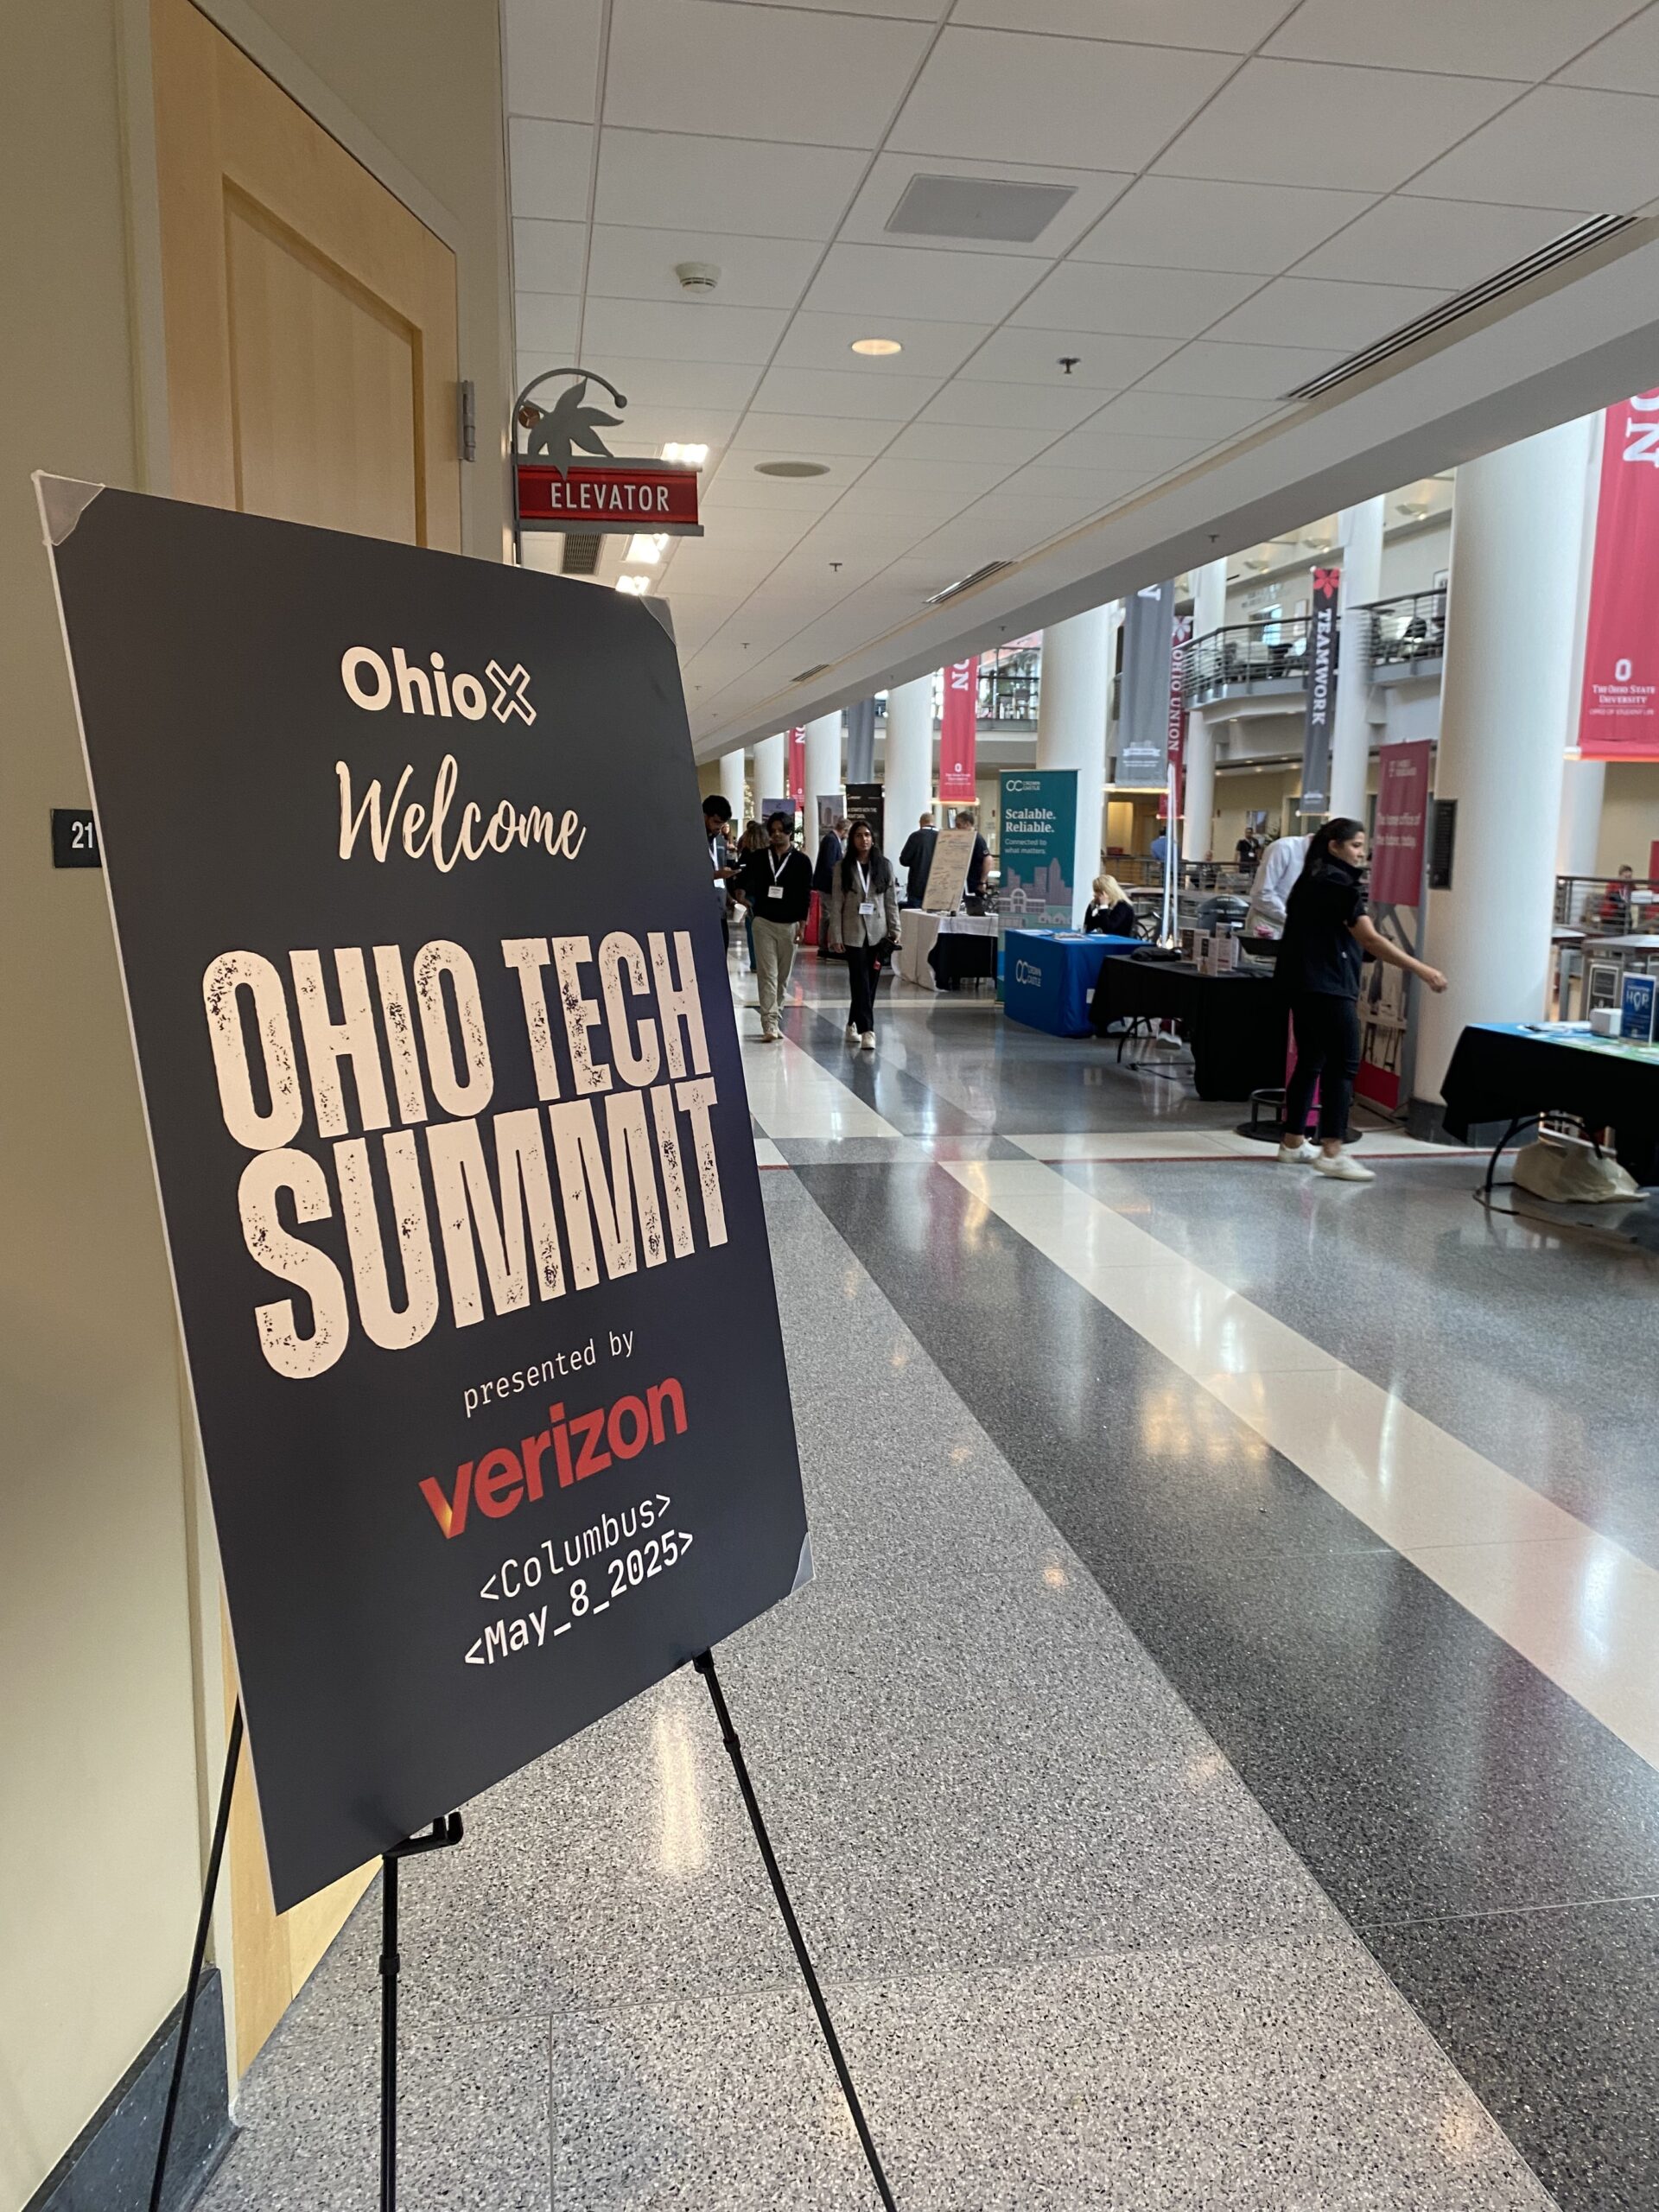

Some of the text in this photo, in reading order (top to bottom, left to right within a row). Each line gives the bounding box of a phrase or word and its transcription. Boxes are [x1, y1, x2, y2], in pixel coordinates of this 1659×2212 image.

[550, 482, 671, 512] ELEVATOR
[340, 645, 537, 727] OhioX
[1168, 649, 1185, 751] OHIO UNION
[1312, 607, 1332, 726] TEAMWORK
[71, 821, 94, 849] 21
[334, 753, 588, 874] Welcome
[1005, 808, 1056, 820] Scalable.
[1005, 821, 1055, 833] Reliable.
[202, 931, 712, 1151] OHIO TECH
[237, 1077, 728, 1380] SUMMIT
[463, 1328, 635, 1419] presented by
[417, 1376, 689, 1540] verizon
[464, 1529, 694, 1666] <May_8_2025>
[480, 1493, 671, 1601] <Columbus>
